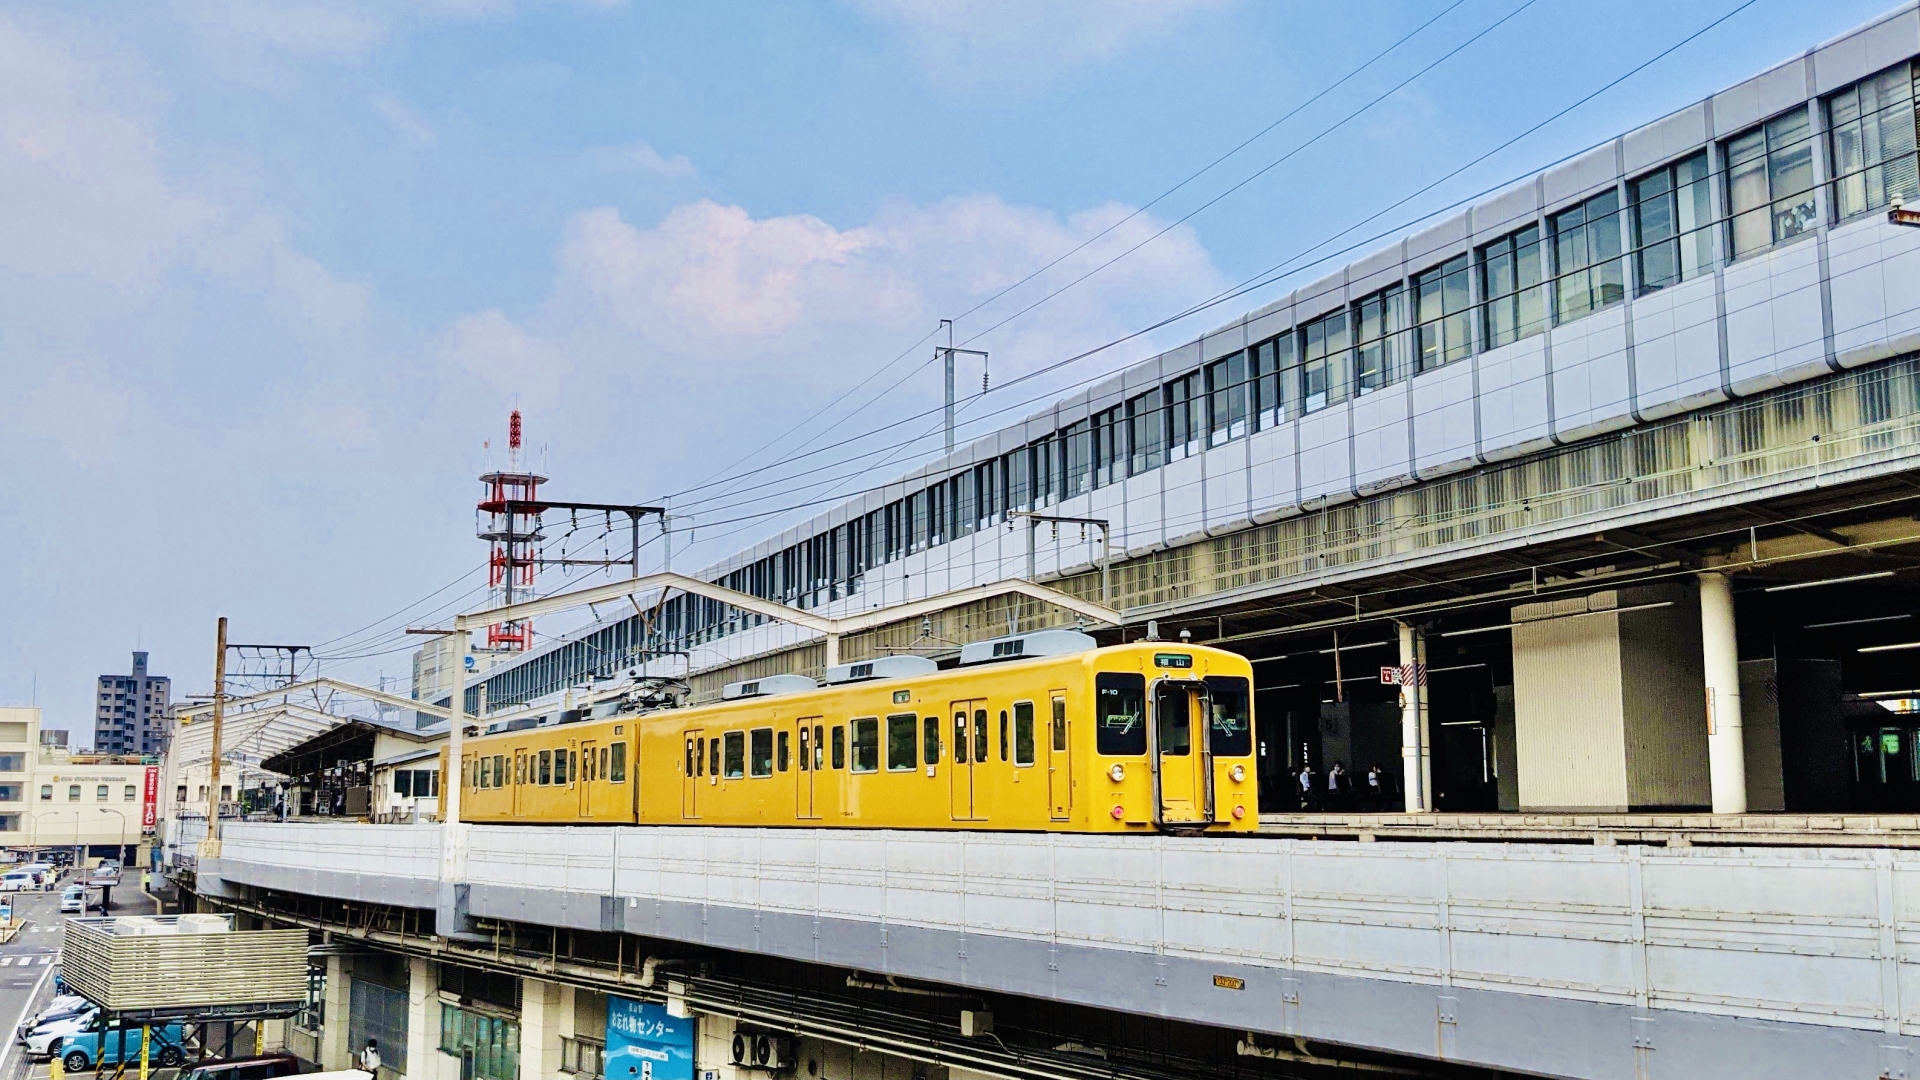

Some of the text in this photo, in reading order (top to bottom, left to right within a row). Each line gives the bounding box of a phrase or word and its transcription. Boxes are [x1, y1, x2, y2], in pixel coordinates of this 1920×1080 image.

[1160, 658, 1184, 666] 福山
[146, 803, 154, 823] TAC
[612, 1010, 674, 1037] お忘れ物センター
